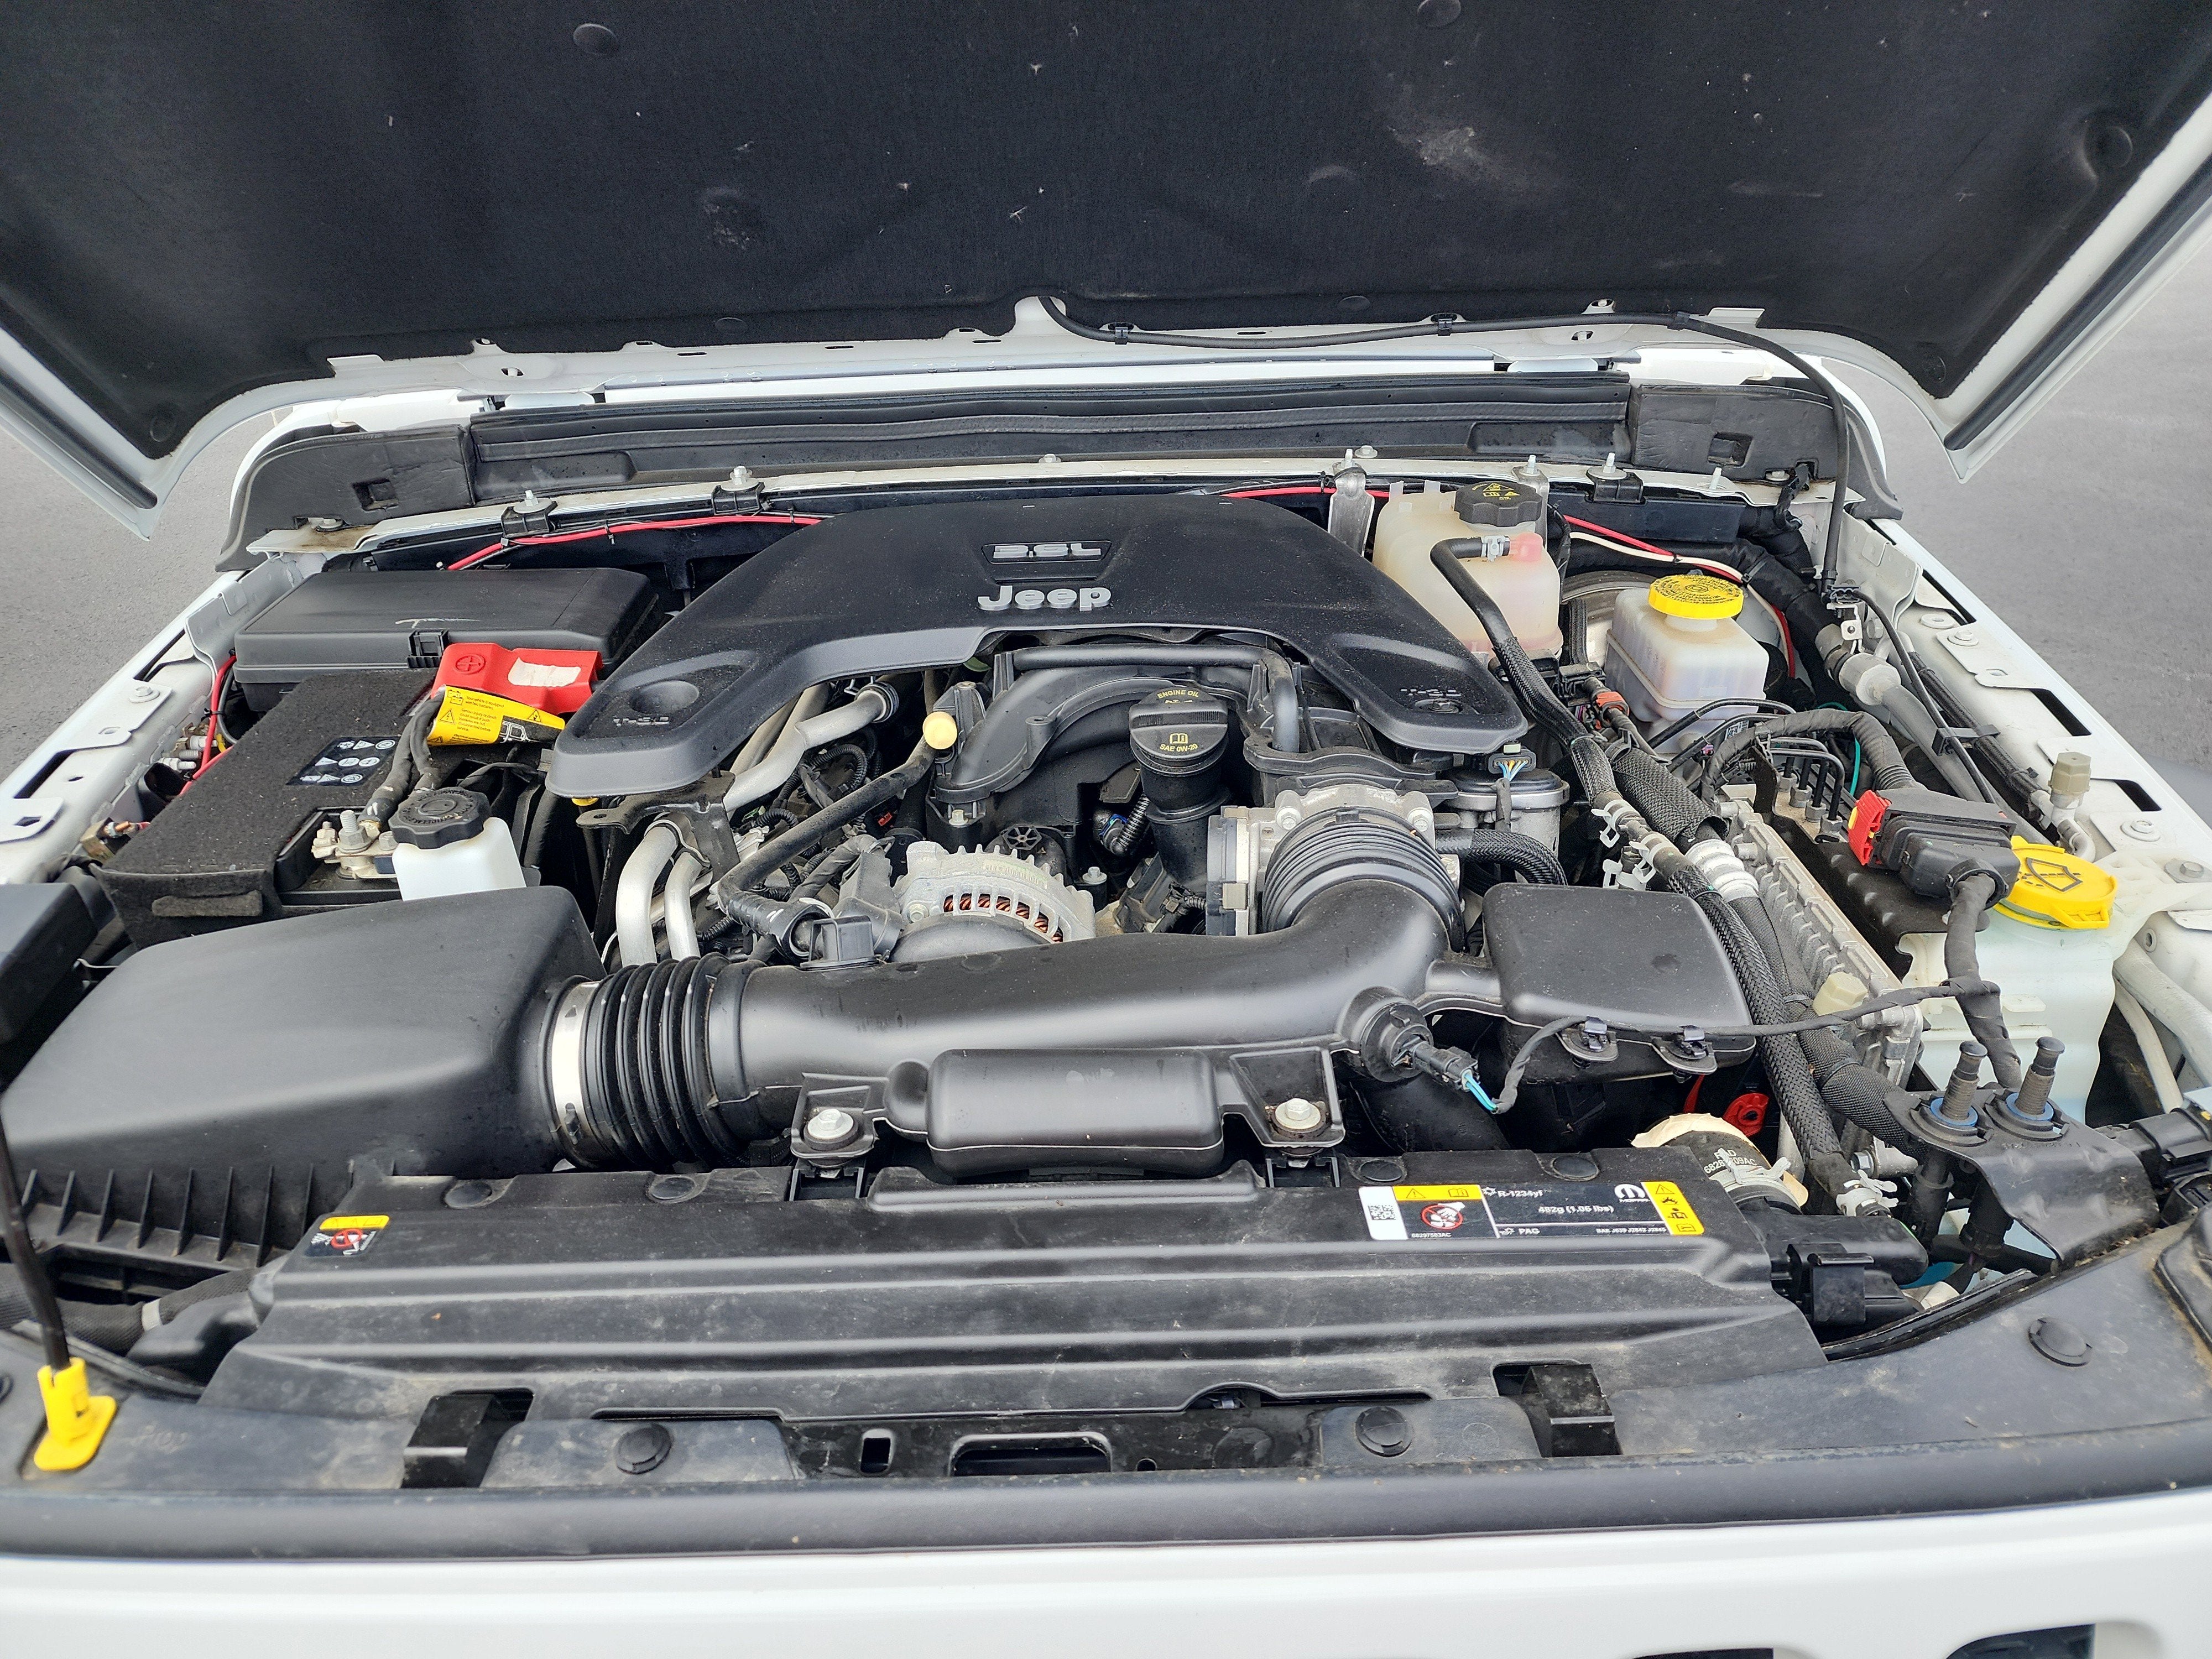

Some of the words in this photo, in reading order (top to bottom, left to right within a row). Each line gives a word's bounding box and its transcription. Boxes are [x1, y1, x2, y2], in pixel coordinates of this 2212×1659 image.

[978, 585, 1111, 611] Jeep
[1157, 690, 1186, 698] ENGINE
[1160, 744, 1175, 752] SAE
[1176, 744, 1198, 752] 0W-20
[1498, 1190, 1543, 1198] R-1234yf
[1593, 1205, 1614, 1214] lbs)
